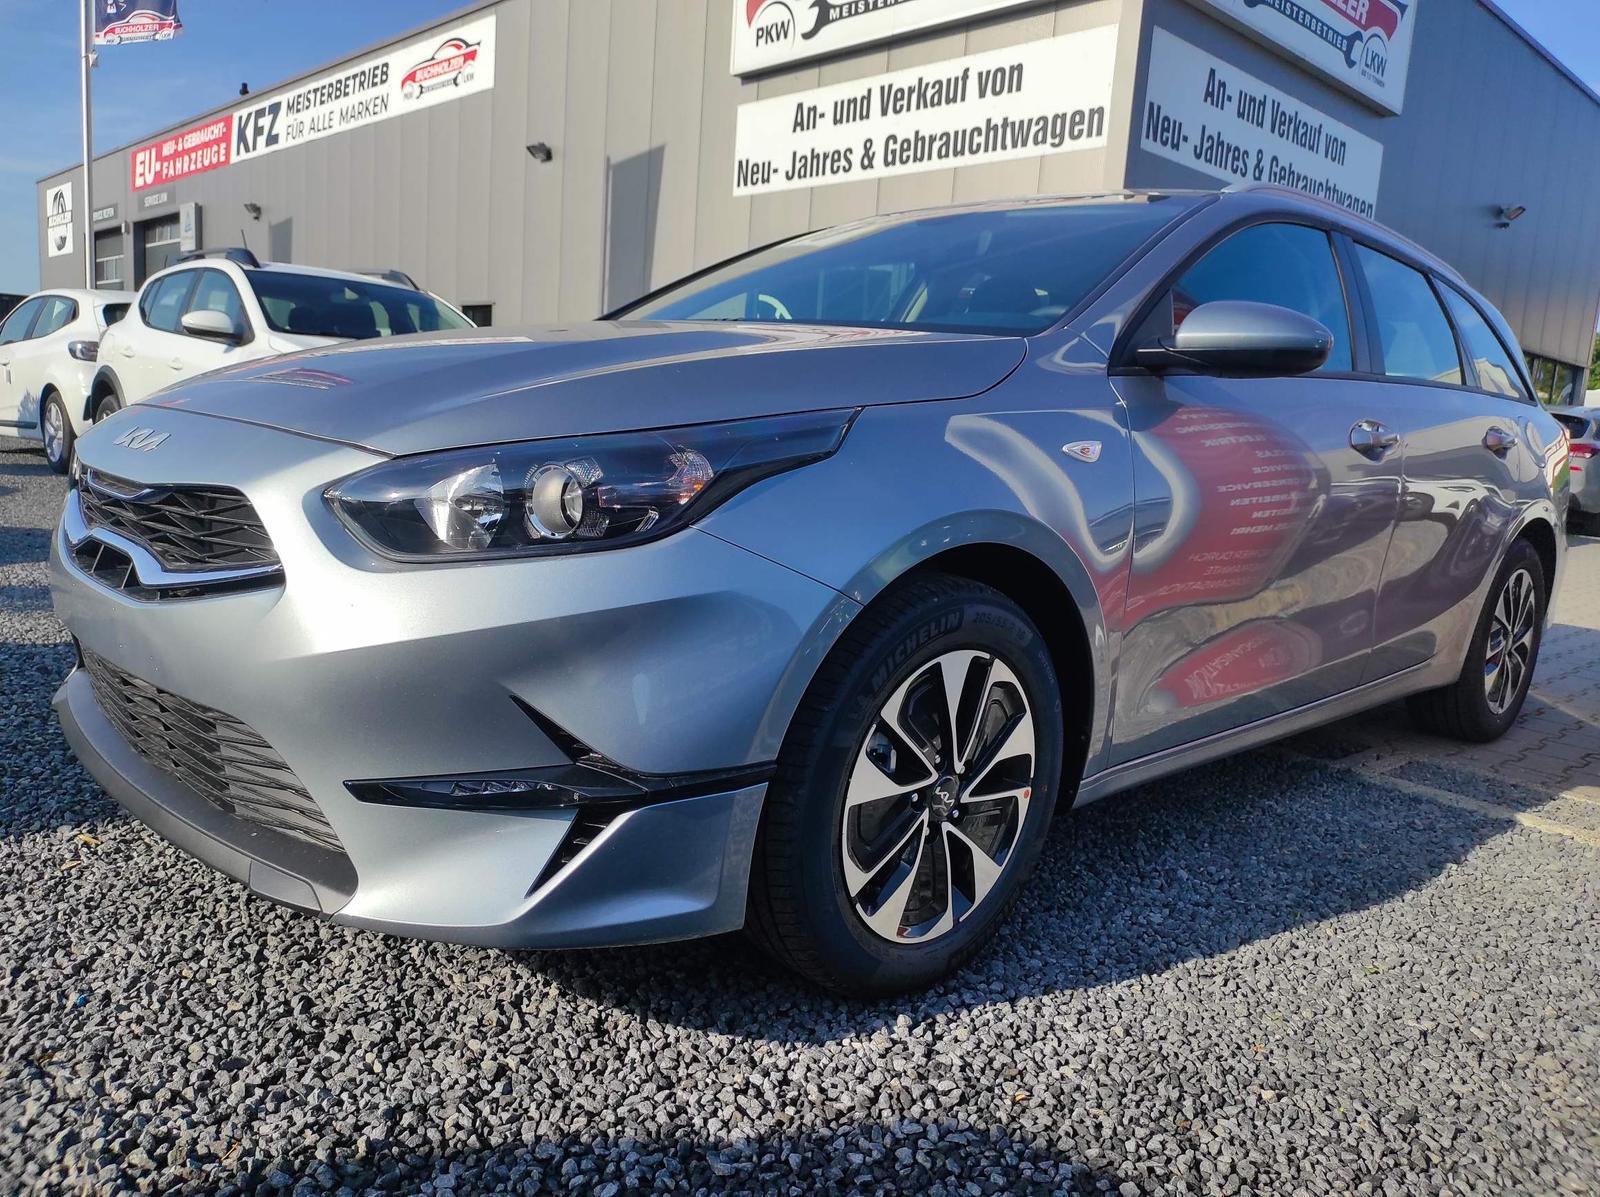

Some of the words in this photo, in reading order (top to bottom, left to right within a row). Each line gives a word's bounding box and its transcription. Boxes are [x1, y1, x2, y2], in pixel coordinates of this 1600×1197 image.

[756, 19, 790, 47] PKW
[1365, 47, 1387, 78] LKW
[286, 62, 389, 117] MEISTERBETRIEB
[793, 102, 826, 132] An-
[833, 89, 870, 126] und
[879, 67, 969, 117] Verkauf
[977, 62, 1024, 99] von
[162, 139, 177, 157] NEU-
[183, 121, 226, 149] GEBRAUCHT-
[236, 101, 281, 156] KFZ
[286, 118, 305, 143] FÜR
[308, 110, 335, 135] ALLE
[339, 93, 389, 126] MARKEN
[1145, 102, 1188, 151] Neu-
[1194, 125, 1248, 178] Jahres
[1253, 149, 1264, 181] &
[1203, 67, 1232, 111] An-
[1237, 89, 1266, 129] und
[1270, 99, 1322, 155] Verkauf
[1325, 132, 1346, 166] von
[135, 147, 161, 188] EU-
[162, 142, 226, 179] FAHRZEUGE
[737, 159, 778, 187] Neu-
[785, 146, 852, 181] Jahres
[860, 138, 876, 170] &
[883, 106, 1105, 167] Gebrauchtwagen
[113, 425, 171, 452] KIA
[871, 611, 961, 692] MICHELIN
